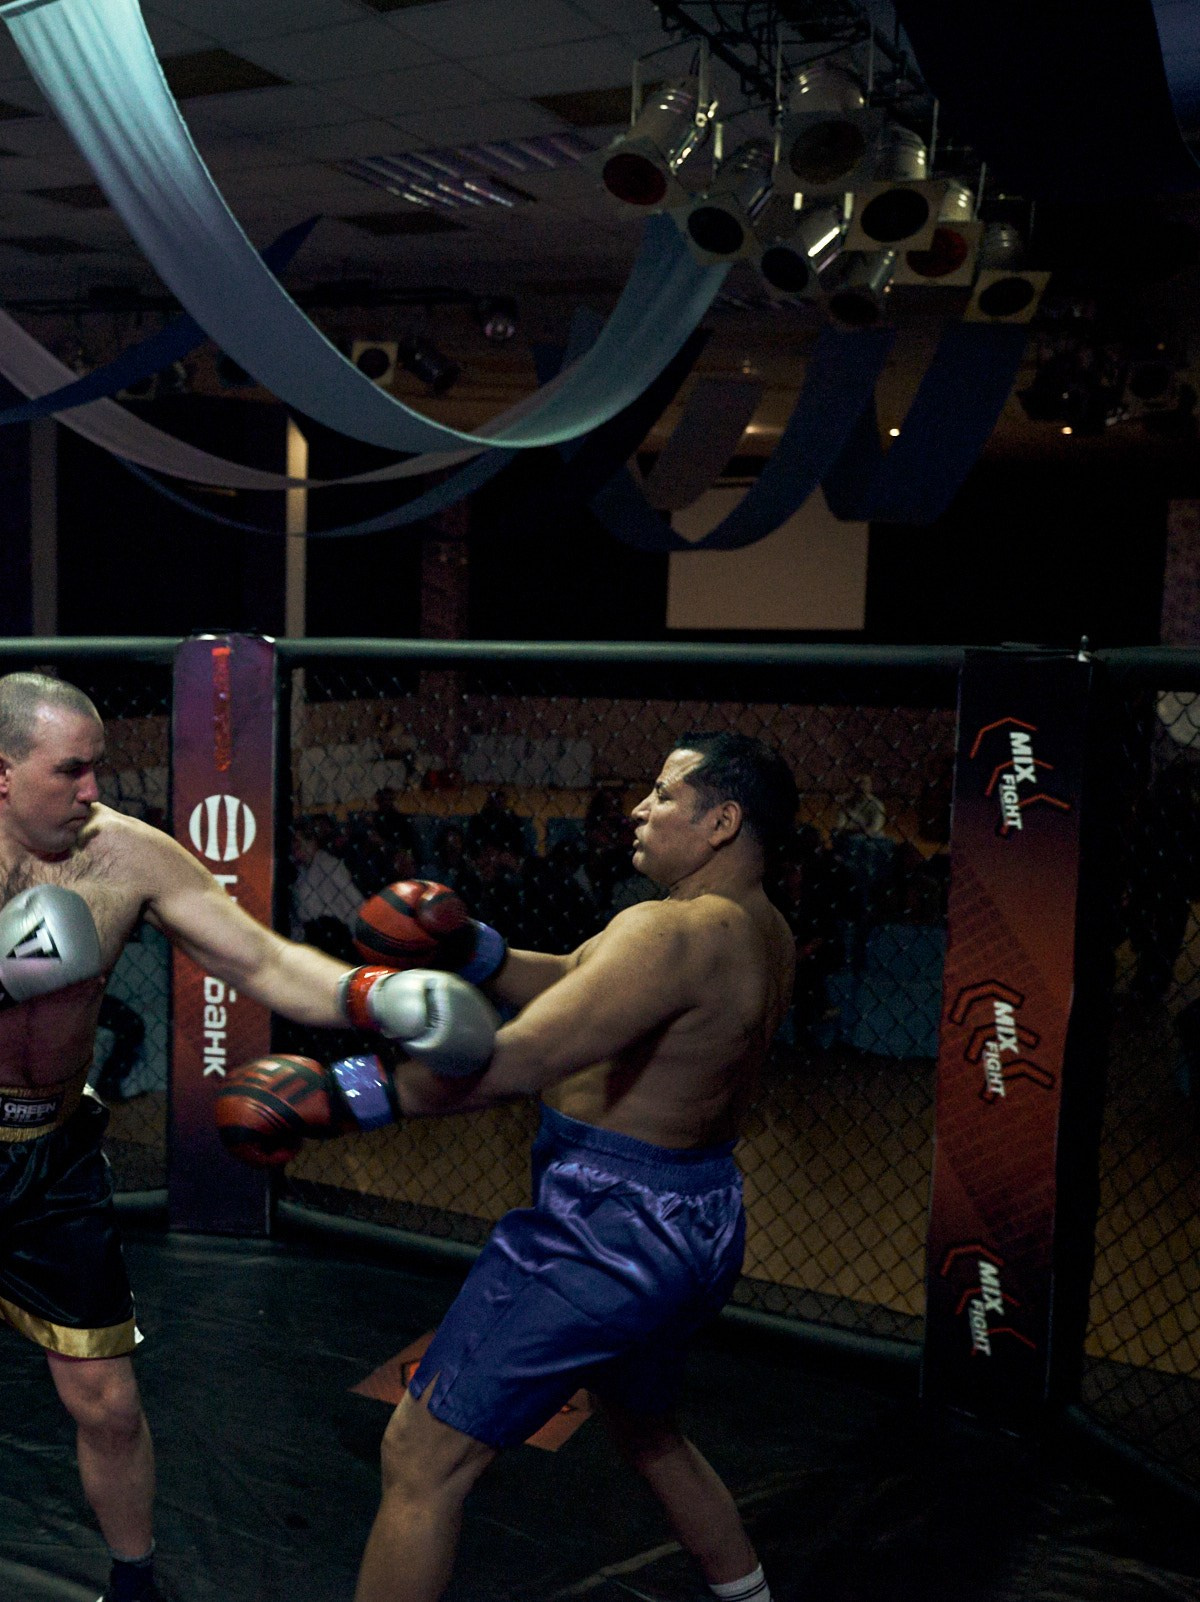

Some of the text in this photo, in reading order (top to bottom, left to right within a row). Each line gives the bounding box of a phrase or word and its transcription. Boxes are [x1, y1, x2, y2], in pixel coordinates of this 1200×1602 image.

[1009, 732, 1037, 783] MIX
[1002, 774, 1023, 830] FIGHT
[993, 1001, 1019, 1053] MIX
[984, 1041, 1006, 1097] FIGHT
[3, 1102, 57, 1114] GREEN
[978, 1260, 1005, 1316] MIX
[970, 1299, 992, 1356] FIGHT
